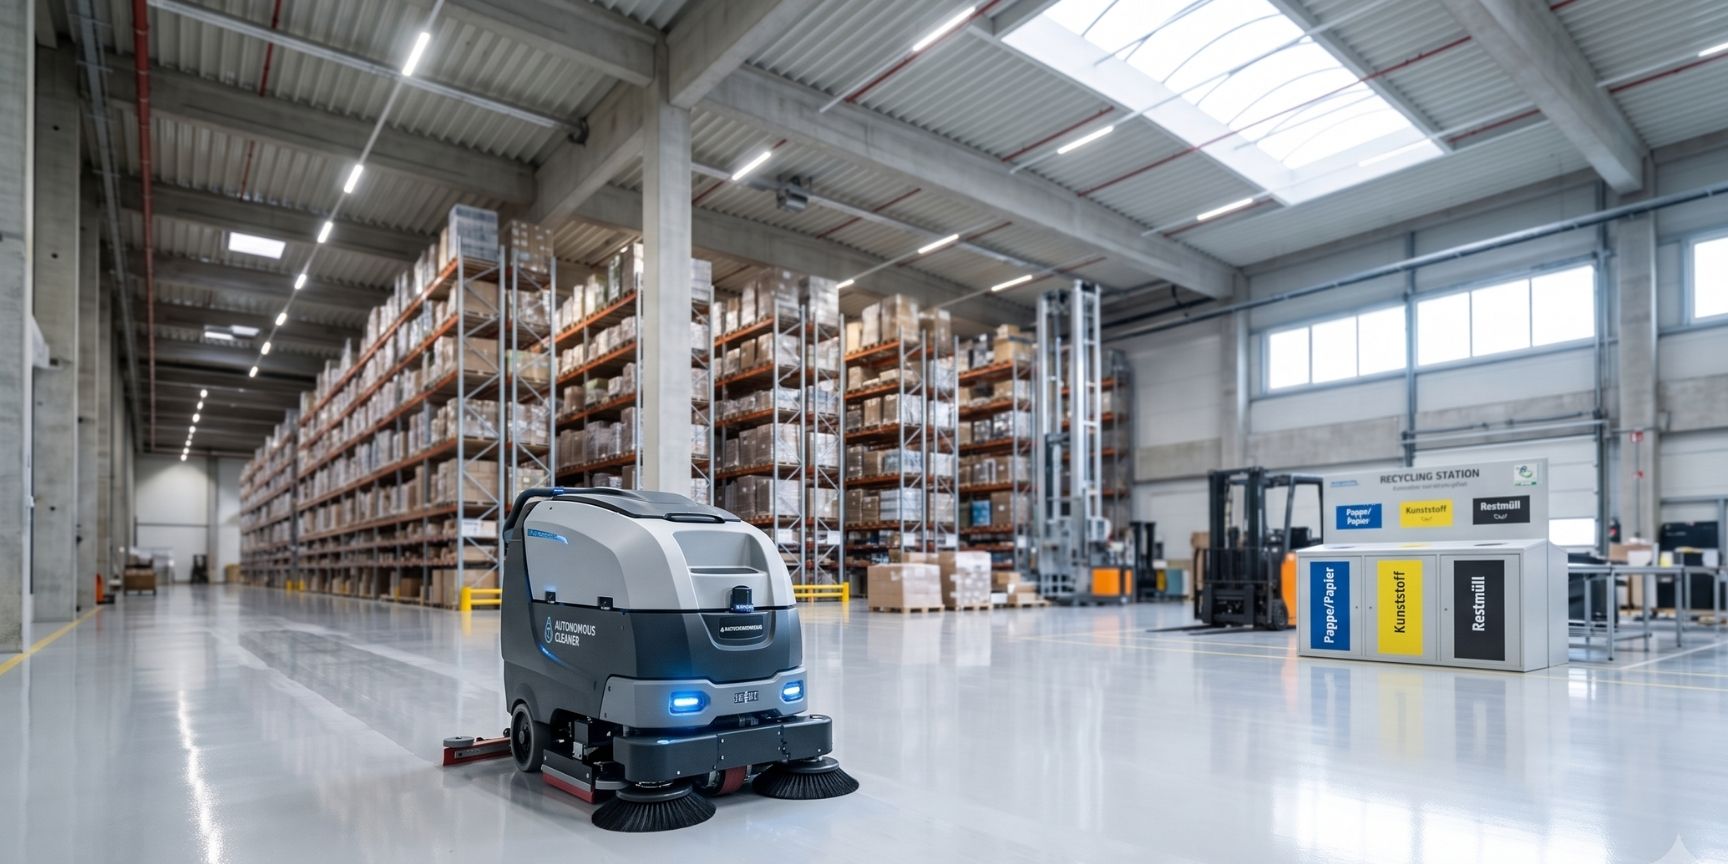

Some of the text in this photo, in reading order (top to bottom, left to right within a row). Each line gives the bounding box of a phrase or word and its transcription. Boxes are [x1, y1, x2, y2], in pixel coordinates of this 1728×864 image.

[1380, 468, 1480, 484] RECYCLING STATION
[1405, 505, 1447, 514] Kunststoff
[1480, 500, 1520, 511] Restmüll
[1324, 567, 1337, 644] Pappe/Papier
[1393, 570, 1406, 633] Kunststoff
[1471, 576, 1485, 631] Restmüll
[554, 619, 596, 636] AUTONOMOUS
[554, 632, 580, 647] CLEANER
